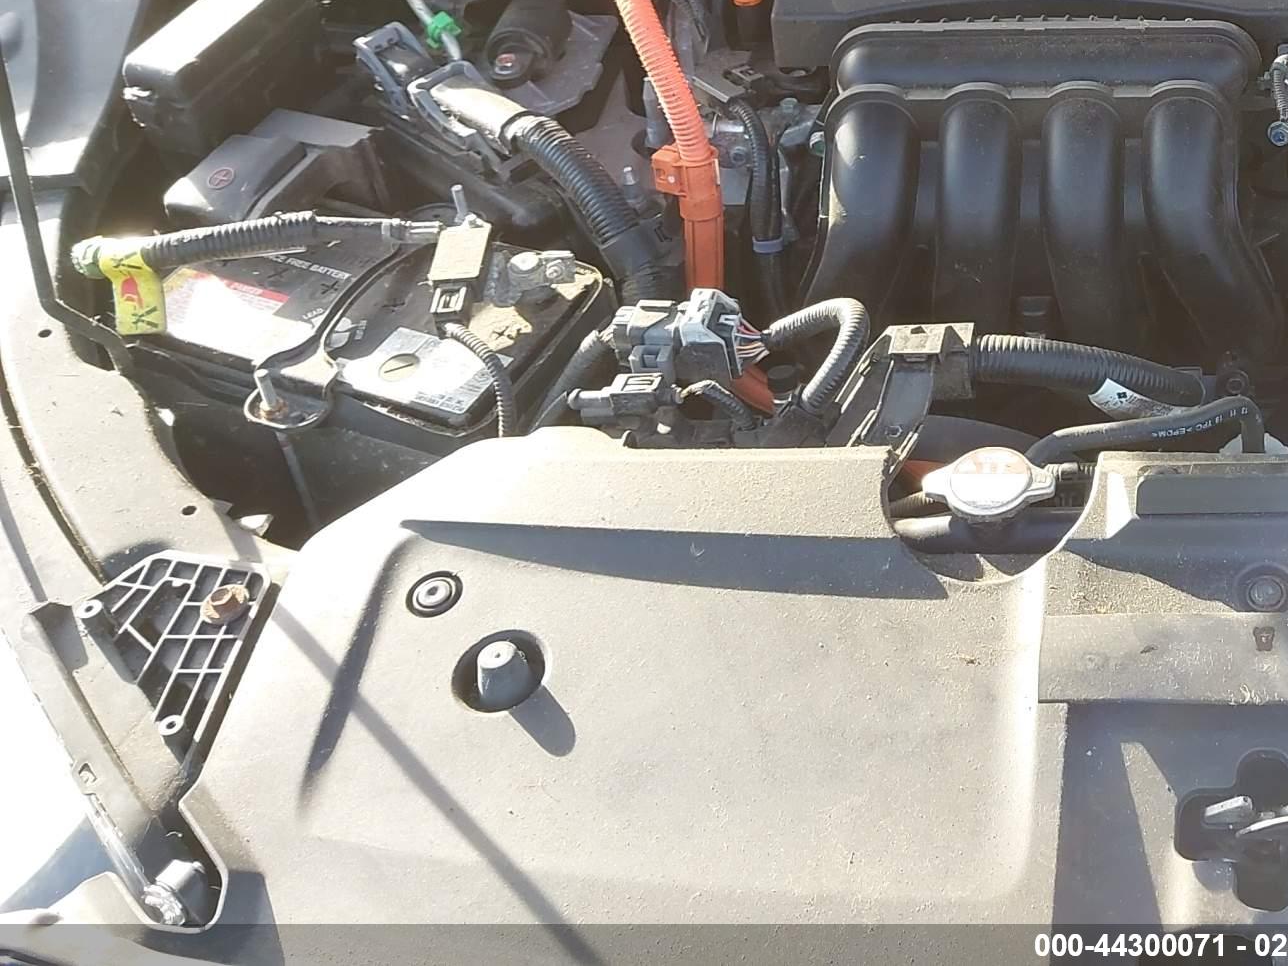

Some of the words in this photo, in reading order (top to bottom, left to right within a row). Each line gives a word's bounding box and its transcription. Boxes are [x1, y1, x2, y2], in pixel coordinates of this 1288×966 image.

[285, 257, 313, 270] FREE
[309, 264, 353, 281] BATTERY
[302, 307, 325, 321] LEAD
[1195, 419, 1212, 432] TPC
